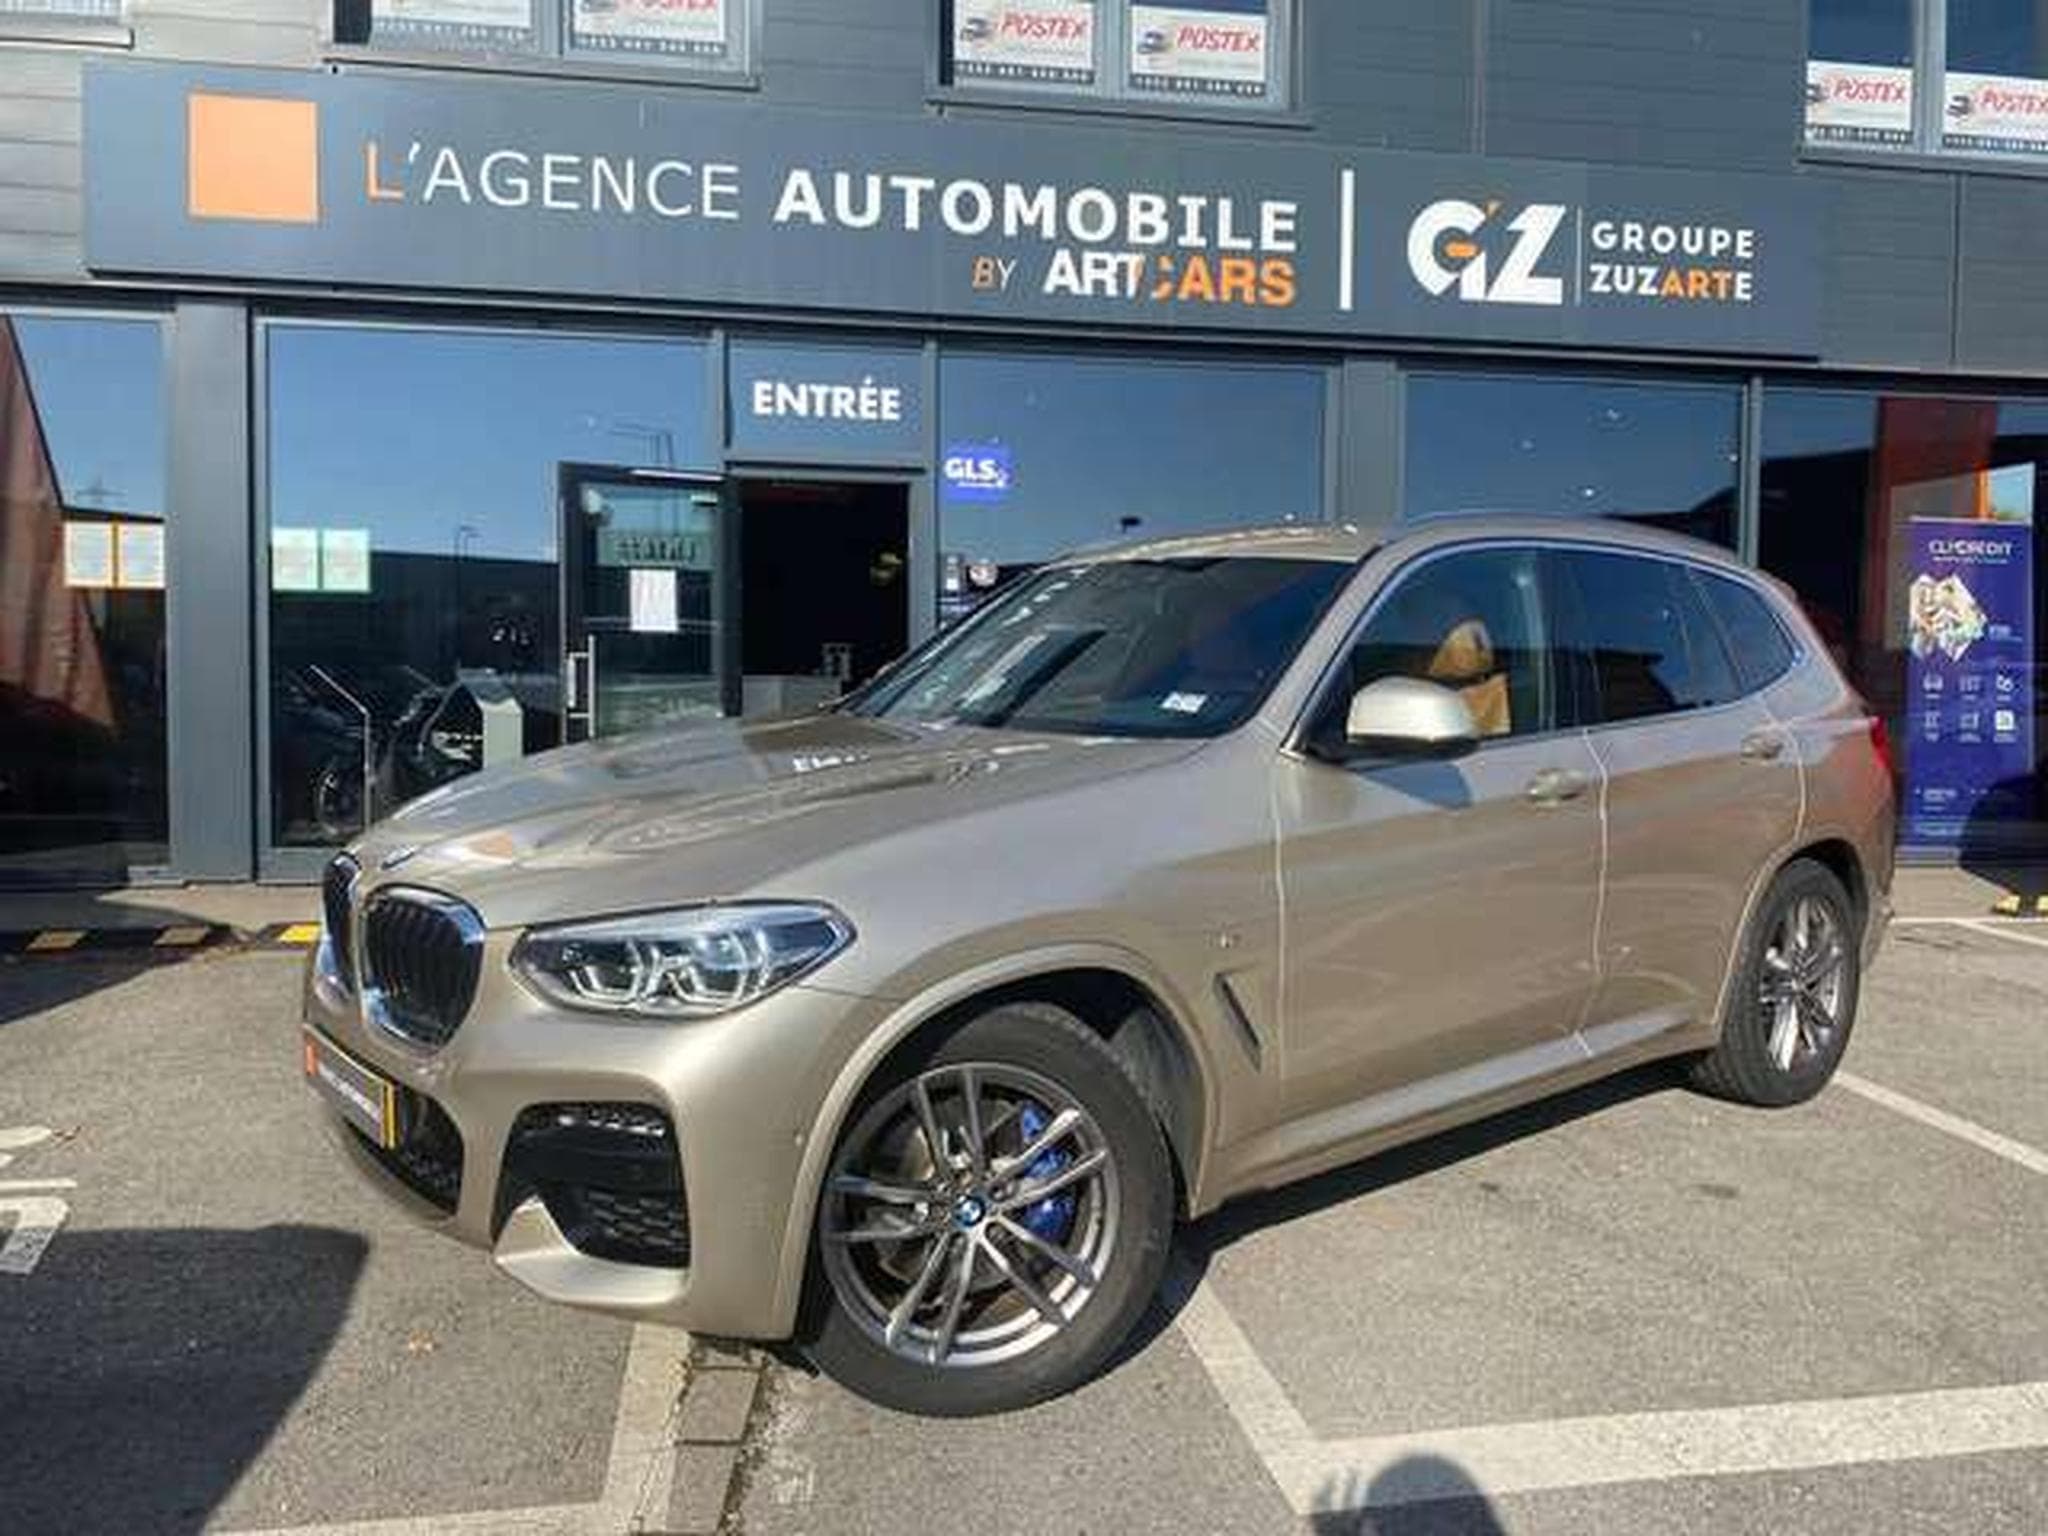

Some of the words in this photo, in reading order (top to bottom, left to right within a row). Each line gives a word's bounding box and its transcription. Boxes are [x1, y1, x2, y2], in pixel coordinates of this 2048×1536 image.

[1000, 12, 1085, 39] POSTEX
[1176, 24, 1260, 53] POSTEX
[1832, 77, 1906, 101] POSTEX
[365, 140, 740, 220] L'AGENCE
[772, 167, 1298, 252] AUTOMOBILE
[1590, 220, 1754, 259] GROUPE
[972, 256, 1015, 290] BY
[1588, 263, 1754, 301] ZUZARTE
[752, 374, 902, 422] ENTRÉE
